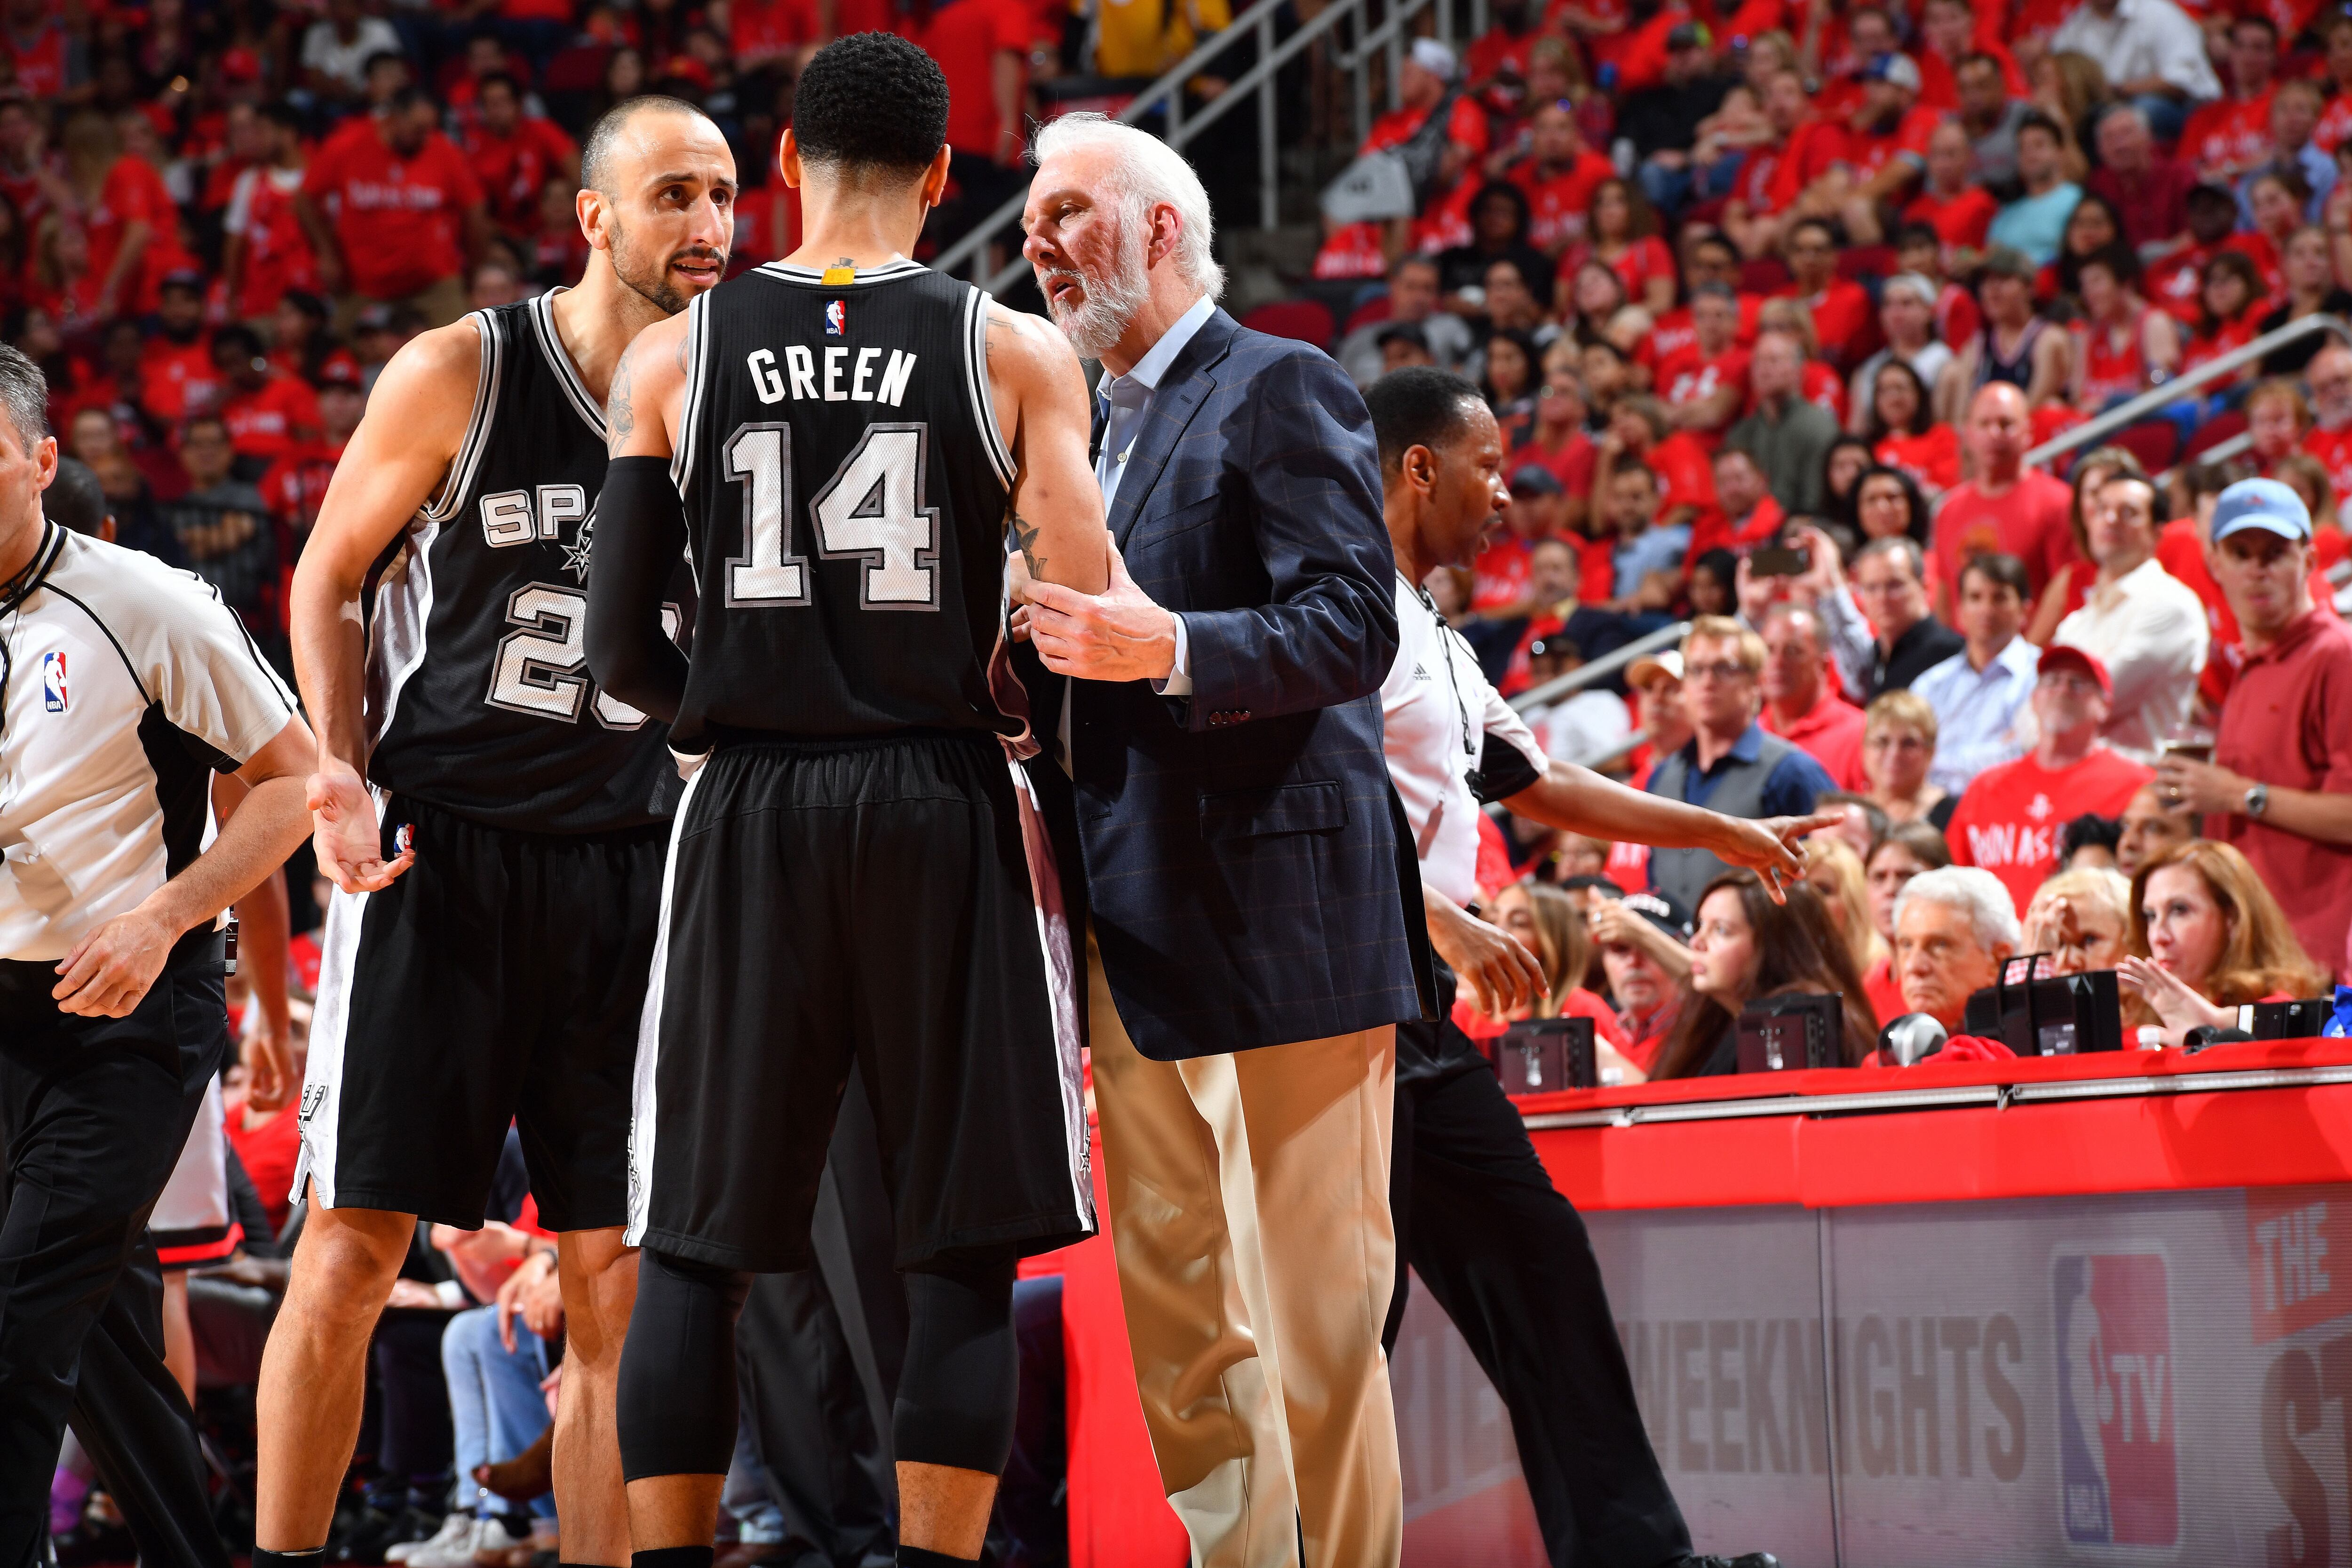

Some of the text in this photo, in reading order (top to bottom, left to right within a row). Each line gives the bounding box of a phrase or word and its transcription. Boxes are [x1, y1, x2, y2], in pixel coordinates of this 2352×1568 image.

[747, 345, 917, 407] GREEN
[722, 422, 940, 612] 14
[47, 700, 62, 710] NBA
[2254, 1201, 2330, 1312] THE
[2112, 1353, 2165, 1443] TV
